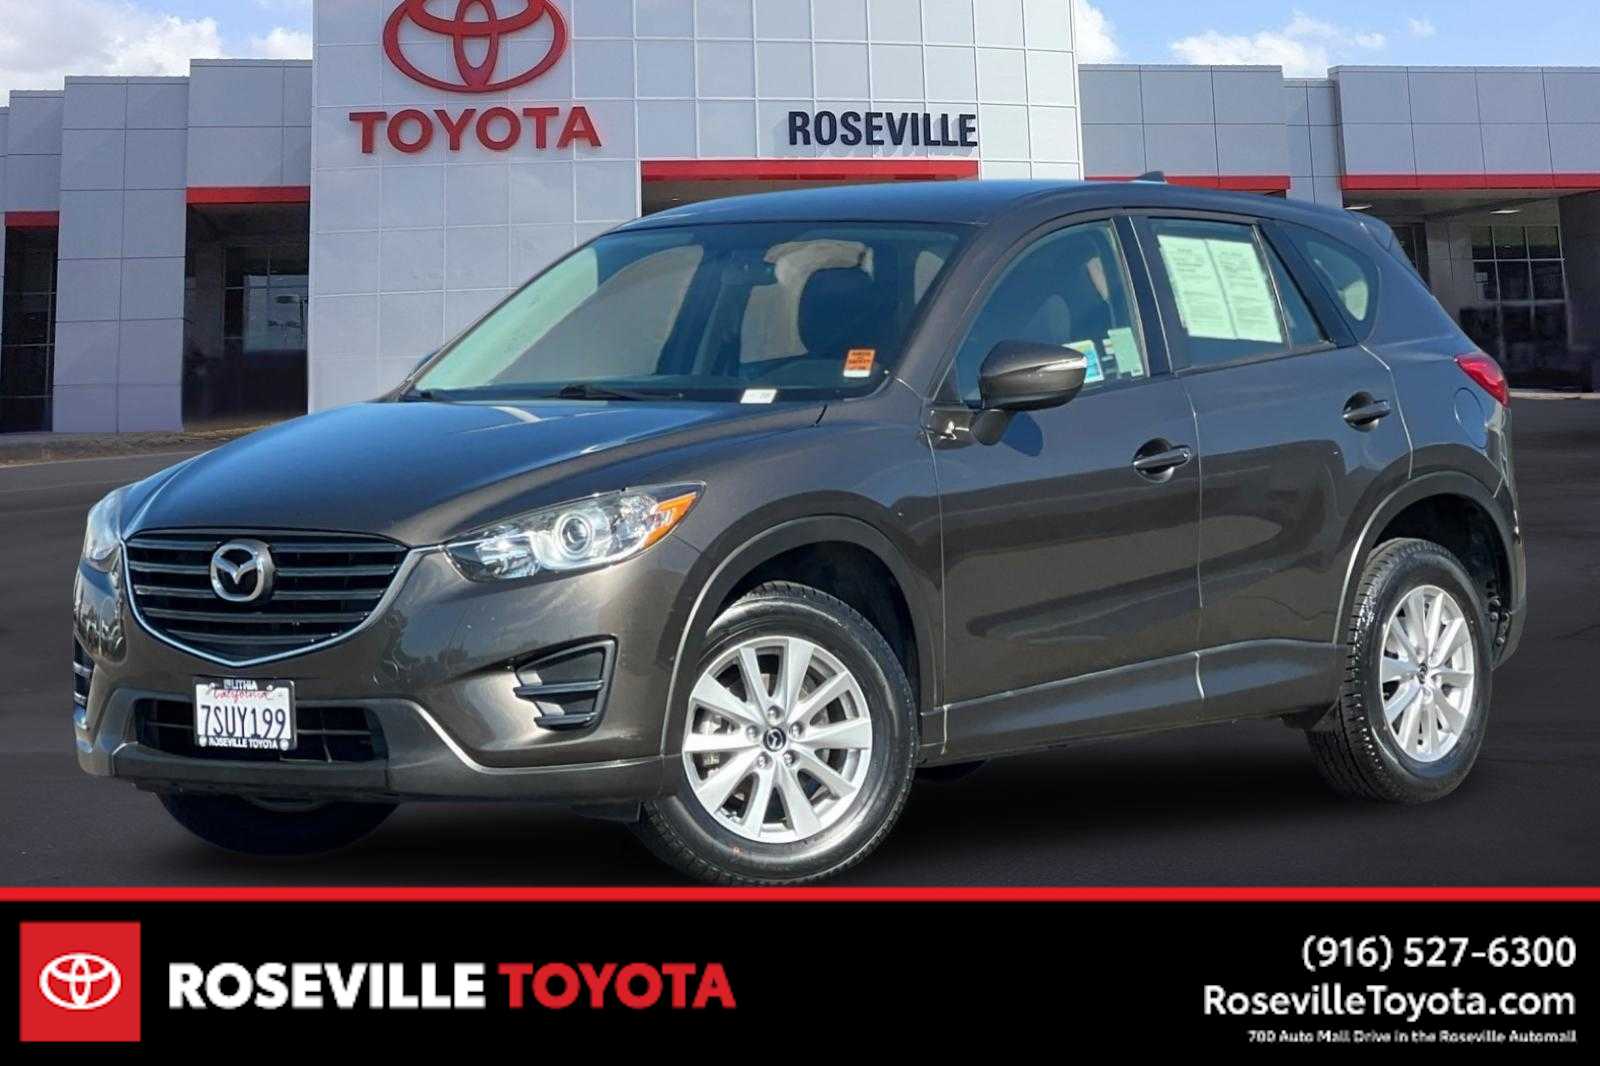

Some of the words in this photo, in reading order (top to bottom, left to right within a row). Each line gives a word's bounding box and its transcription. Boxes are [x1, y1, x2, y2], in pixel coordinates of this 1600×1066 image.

[349, 106, 602, 154] TOYOTA
[788, 111, 978, 147] ROSEVILLE
[201, 704, 286, 739] 7SUY199
[208, 737, 248, 749] ROSEVILLE
[249, 738, 279, 750] TOYOTA
